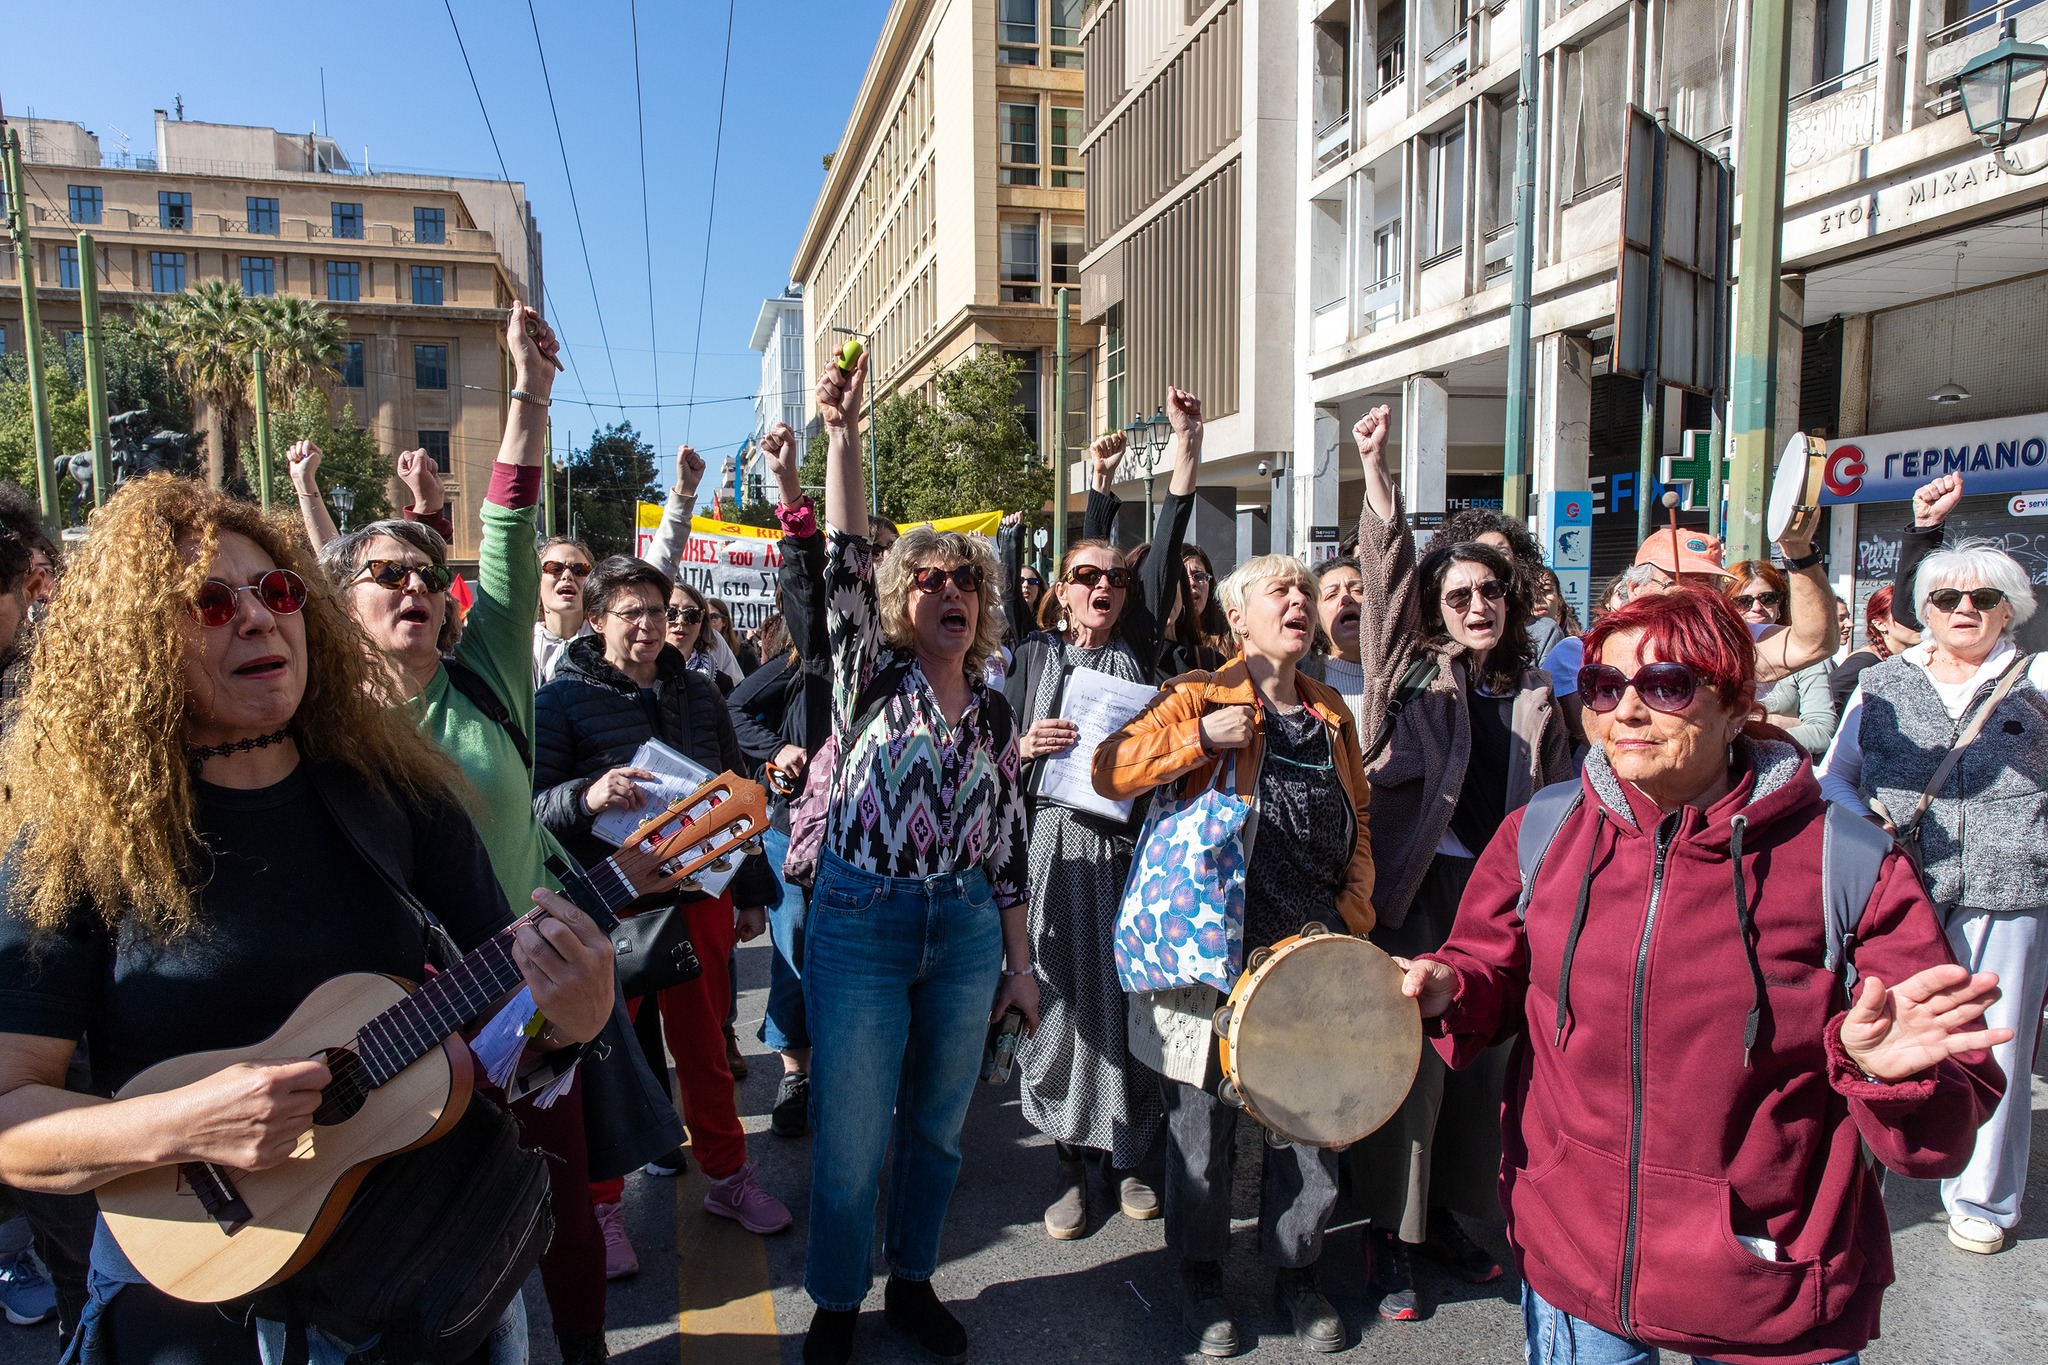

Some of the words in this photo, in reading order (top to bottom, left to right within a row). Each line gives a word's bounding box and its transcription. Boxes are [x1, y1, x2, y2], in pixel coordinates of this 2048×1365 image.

[1820, 199, 1881, 235] ΣΤΟΑ
[1884, 438, 2048, 480] ΓΕΡΜΑΝΟ
[1446, 498, 1470, 509] THE
[1471, 498, 1503, 509] FIXE
[729, 551, 752, 566] του
